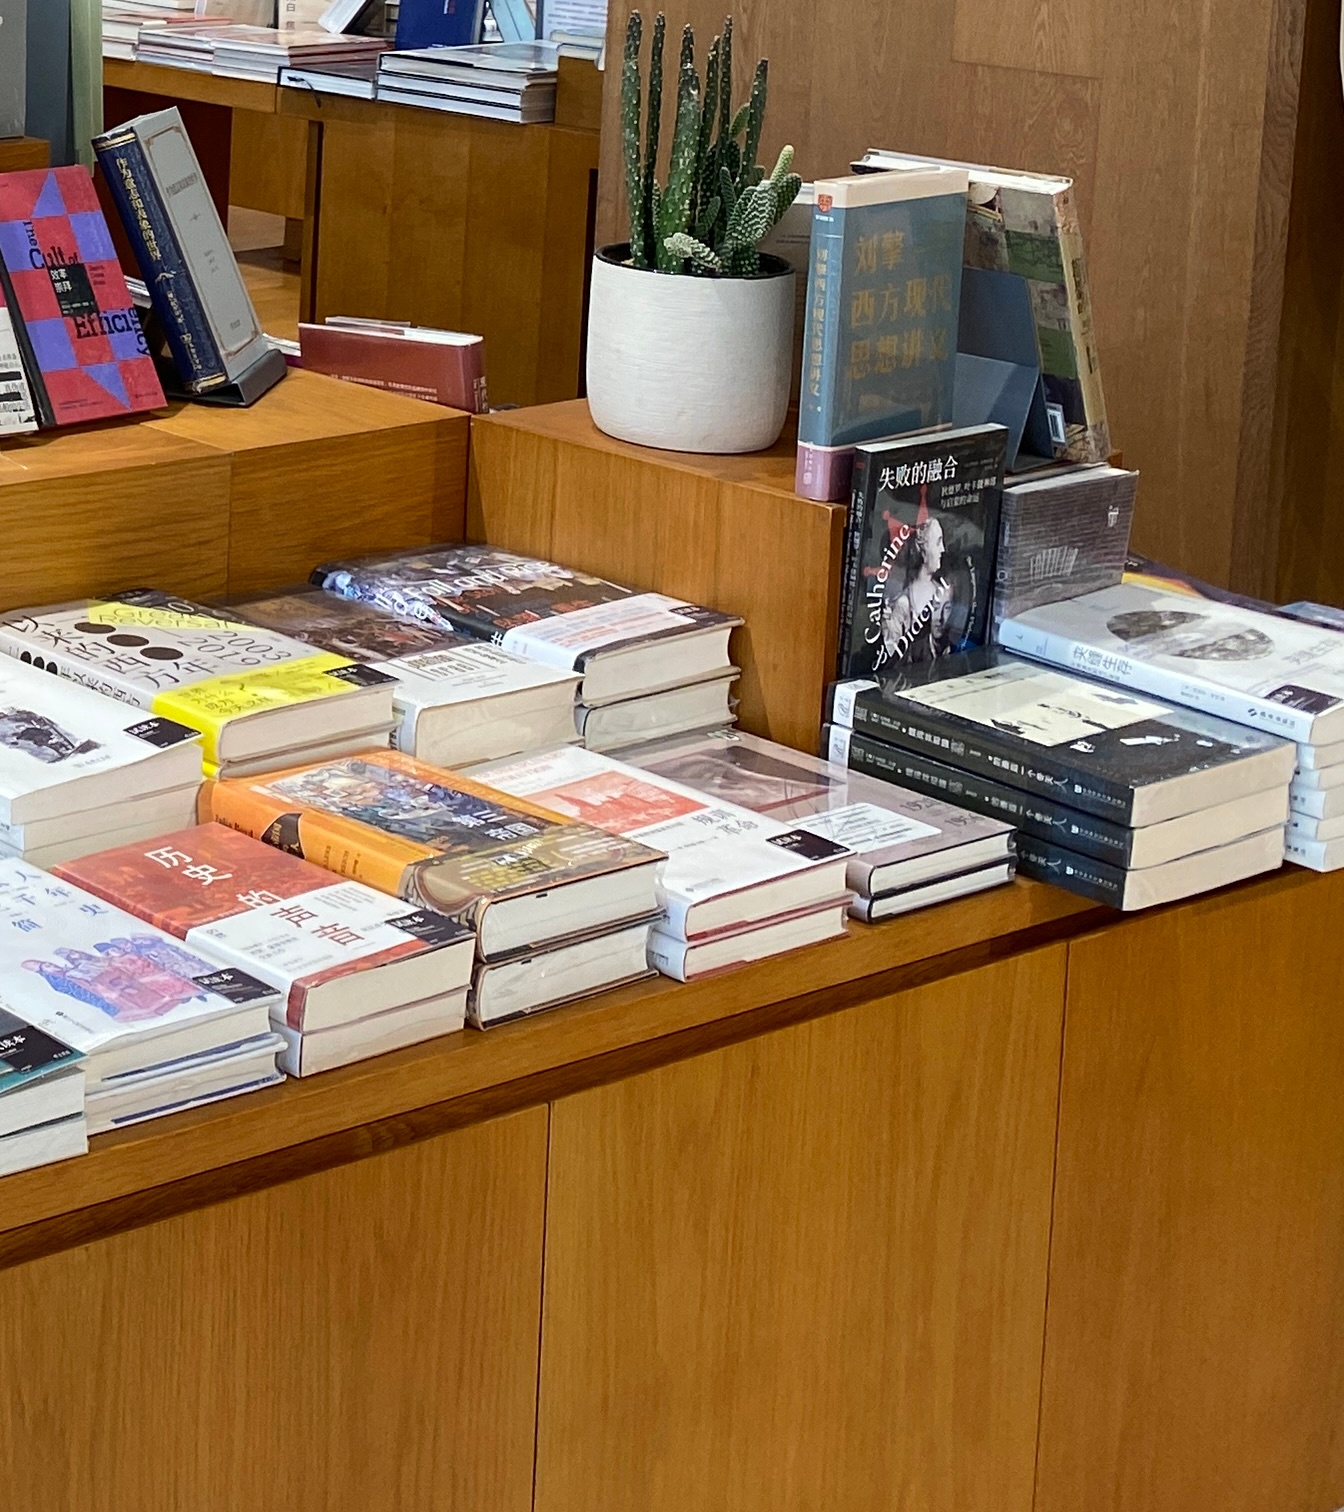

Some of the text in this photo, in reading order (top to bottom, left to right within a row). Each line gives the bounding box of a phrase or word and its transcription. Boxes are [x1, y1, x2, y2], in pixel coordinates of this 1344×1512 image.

[28, 245, 66, 271] Cult
[856, 229, 905, 276] 刘擎
[50, 268, 68, 280] 效率
[55, 281, 73, 294] 崇拜
[850, 275, 953, 327] 西方现代
[846, 325, 949, 379] 思想讲义
[879, 454, 959, 492] 失败的融合
[864, 523, 912, 646] Catherine
[97, 612, 229, 630] Reversal
[892, 577, 952, 660] Diderot
[178, 636, 262, 667] 2019
[207, 630, 293, 662] 2003
[715, 820, 759, 837] 革命
[196, 970, 234, 987] 试读本
